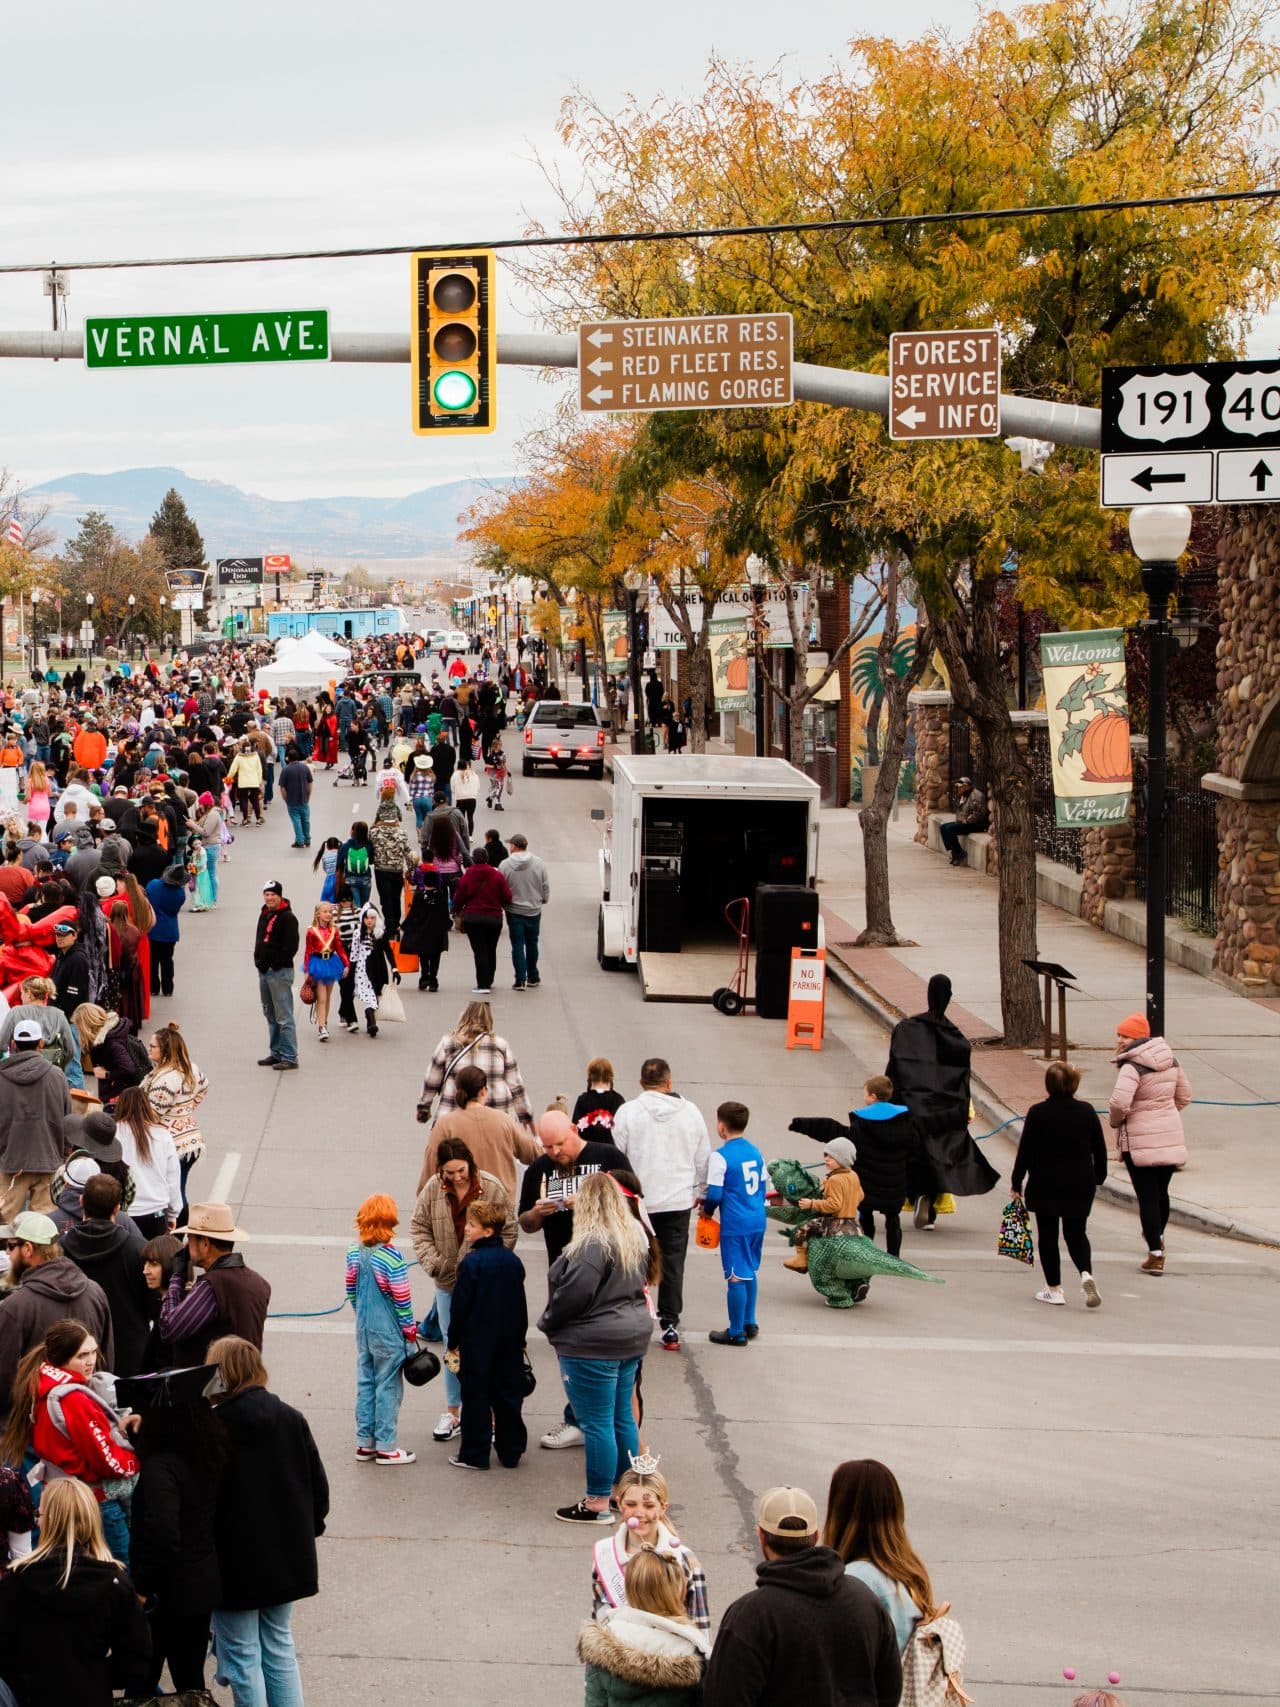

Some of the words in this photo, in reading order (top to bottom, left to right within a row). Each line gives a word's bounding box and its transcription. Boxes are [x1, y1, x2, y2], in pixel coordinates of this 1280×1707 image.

[91, 324, 230, 358] VERNAL
[251, 320, 324, 352] AVE.
[622, 325, 729, 348] STEINAKER
[738, 322, 785, 344] RES.
[622, 356, 661, 376] RED
[670, 352, 732, 375] FLEET
[738, 350, 785, 371] RES.
[898, 338, 992, 366] FOREST
[622, 381, 710, 404] FLAMING
[720, 377, 785, 399] GORGE
[894, 371, 996, 399] SERVICE
[937, 403, 996, 429] INFO
[1136, 390, 1193, 427] 191
[1228, 386, 1280, 422] 40
[1045, 645, 1122, 664] Welcome
[1062, 798, 1128, 823] Vernal
[1083, 797, 1097, 809] to
[792, 981, 821, 991] PARKING
[801, 969, 815, 979] NO
[579, 1163, 603, 1176] THE
[741, 1159, 759, 1196] 5
